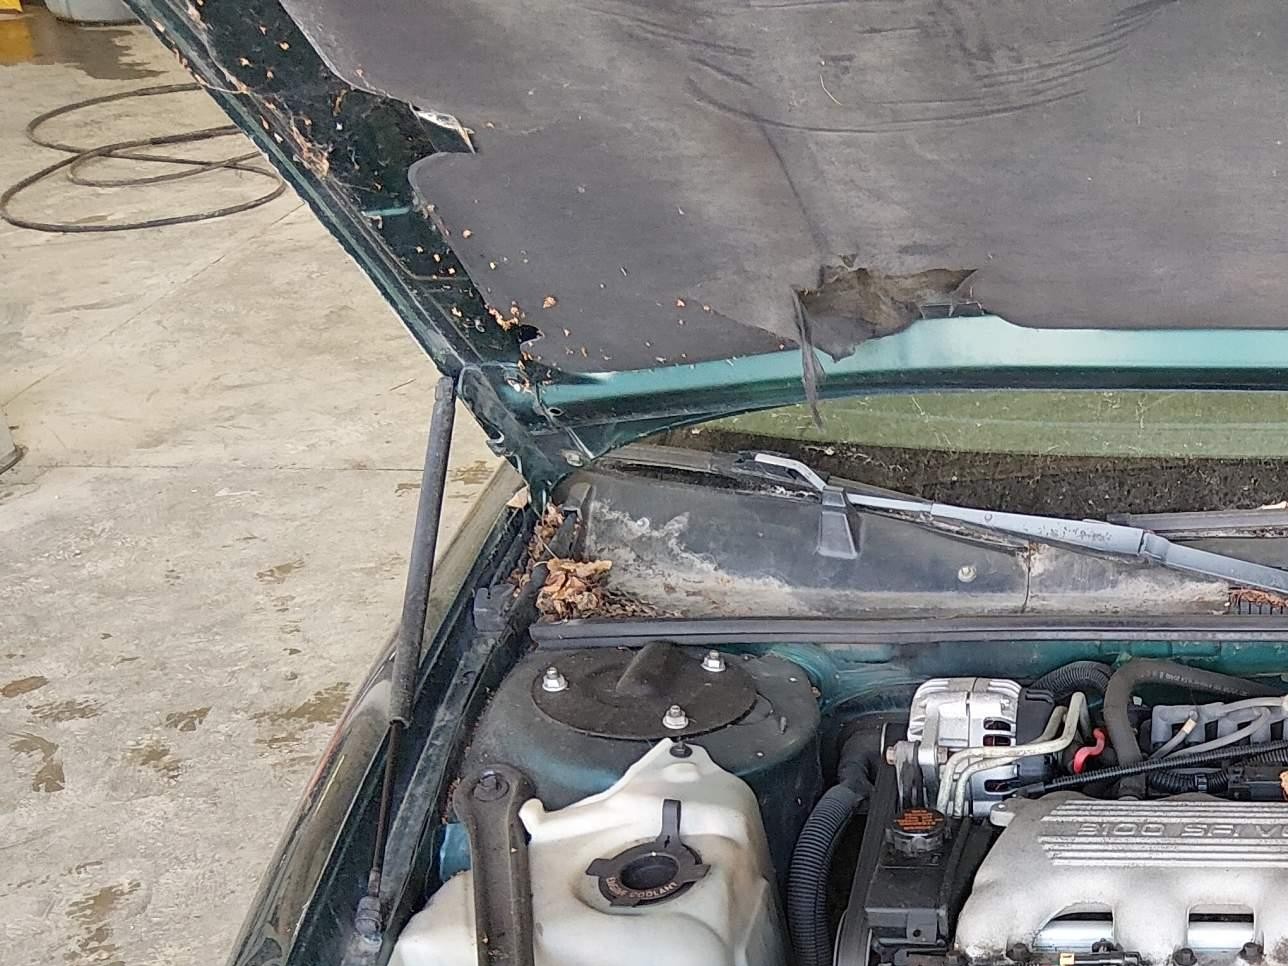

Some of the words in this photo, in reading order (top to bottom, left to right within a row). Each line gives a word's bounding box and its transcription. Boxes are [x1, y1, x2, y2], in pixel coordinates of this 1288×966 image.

[1077, 823, 1166, 837] 3100
[1181, 823, 1240, 838] SFI
[629, 881, 679, 898] COOLANT
